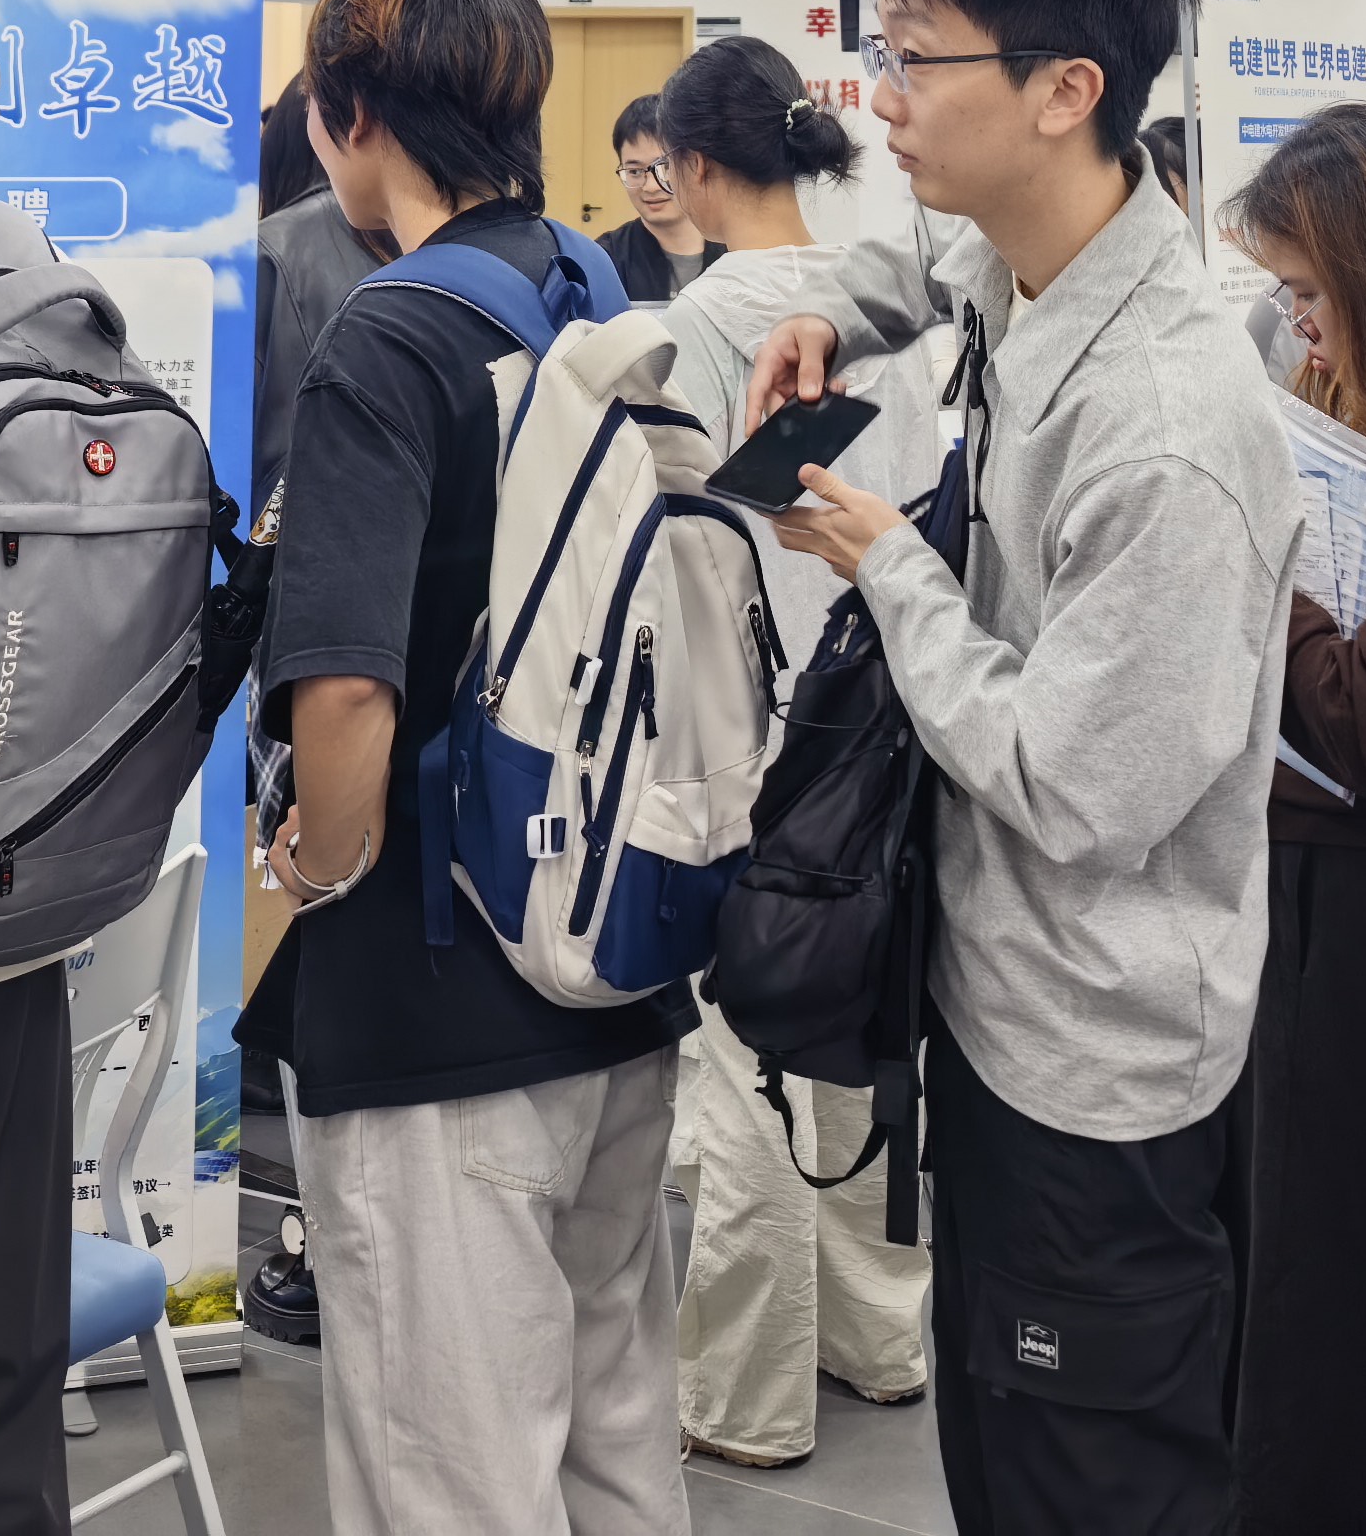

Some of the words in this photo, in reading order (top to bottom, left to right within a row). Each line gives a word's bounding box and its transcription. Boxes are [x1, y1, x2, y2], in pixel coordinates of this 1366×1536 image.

[806, 7, 836, 37] 幸
[1229, 35, 1298, 79] 电建世界
[1021, 1336, 1056, 1357] Jeep
